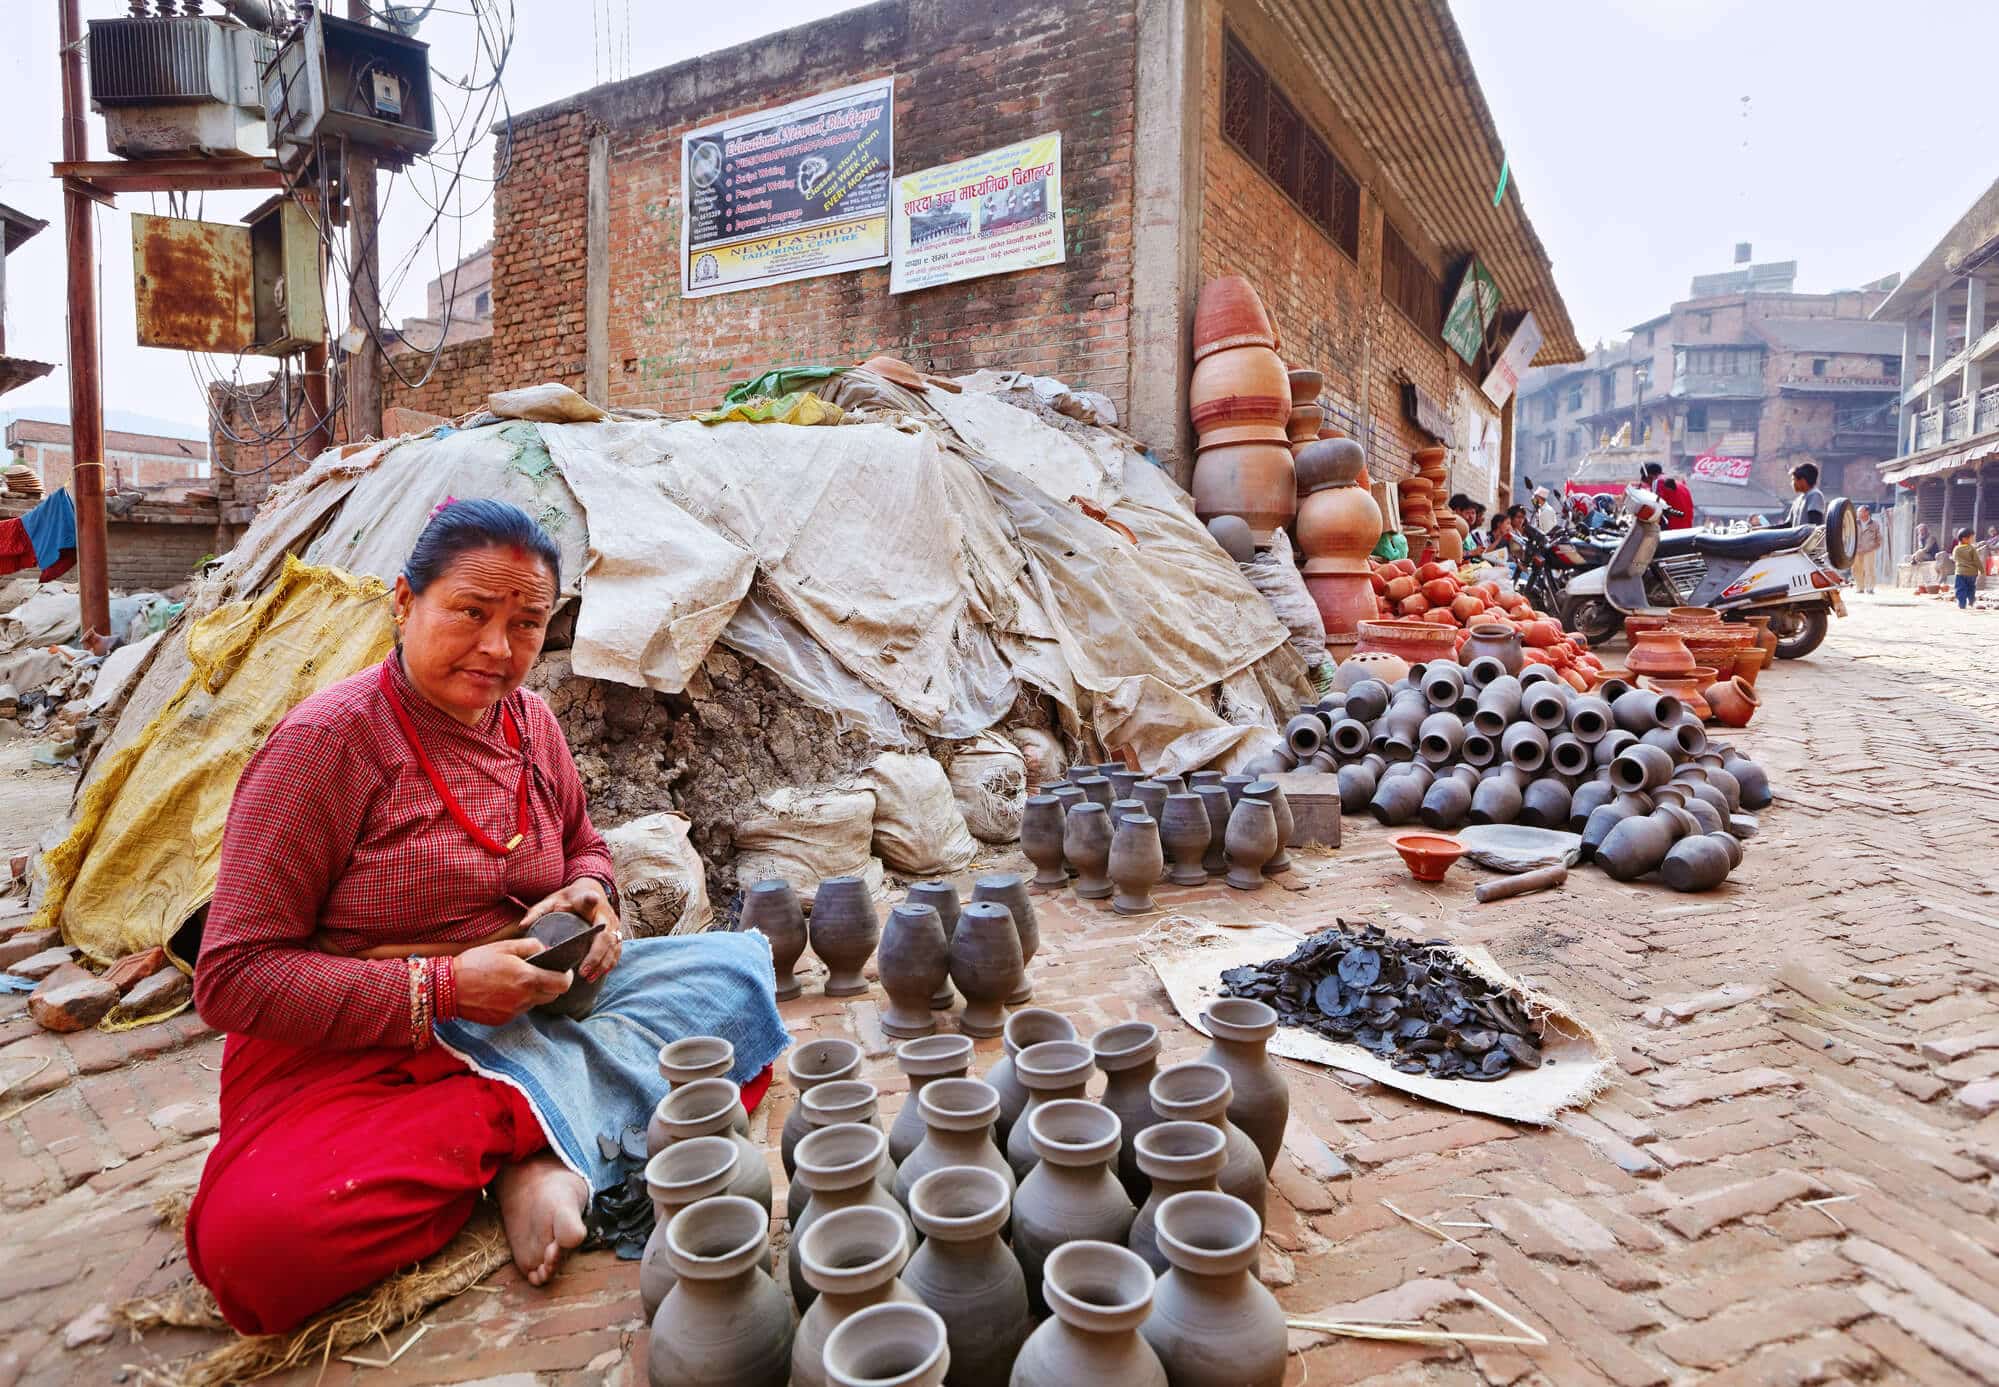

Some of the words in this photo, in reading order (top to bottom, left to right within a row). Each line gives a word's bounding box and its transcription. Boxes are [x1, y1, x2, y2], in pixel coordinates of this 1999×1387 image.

[837, 149, 857, 171] start
[857, 129, 879, 151] from
[823, 186, 847, 211] EVERY
[847, 157, 879, 189] MONTH
[838, 160, 860, 182] WEEK
[904, 194, 932, 216] शारदा
[935, 190, 956, 207] उच्च
[960, 175, 1009, 201] माध्यमिक
[1012, 162, 1055, 186] विद्यालय
[731, 241, 771, 256] NEW
[777, 224, 867, 247] FASHION
[741, 244, 804, 261] TAILORING
[808, 233, 858, 249] CENTRE
